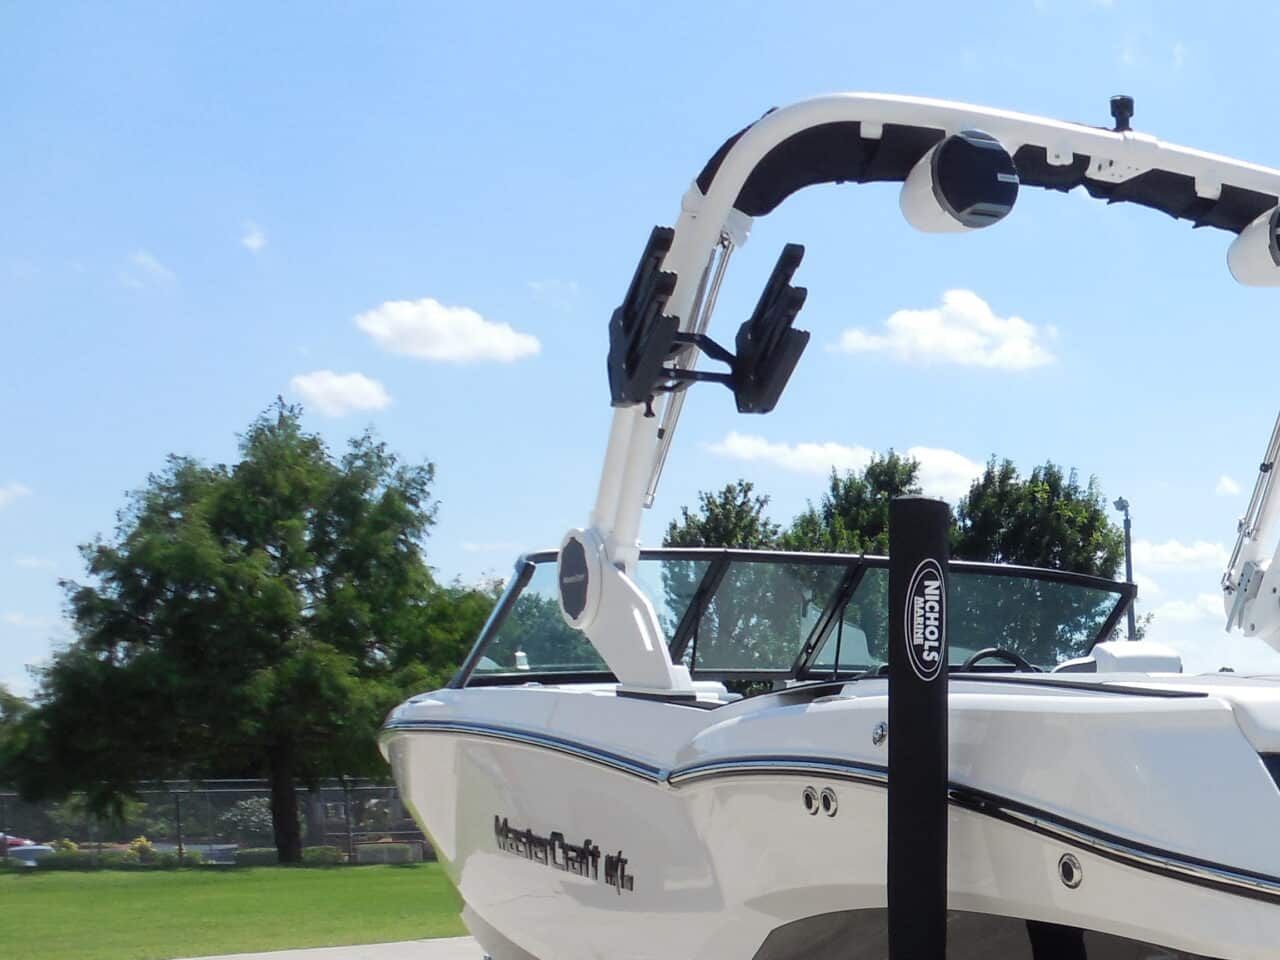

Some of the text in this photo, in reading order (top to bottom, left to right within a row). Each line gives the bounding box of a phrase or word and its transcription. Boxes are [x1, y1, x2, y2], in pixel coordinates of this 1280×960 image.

[914, 596, 925, 646] MARINE
[922, 580, 941, 662] NICHOLS
[494, 815, 601, 880] MasterCraft
